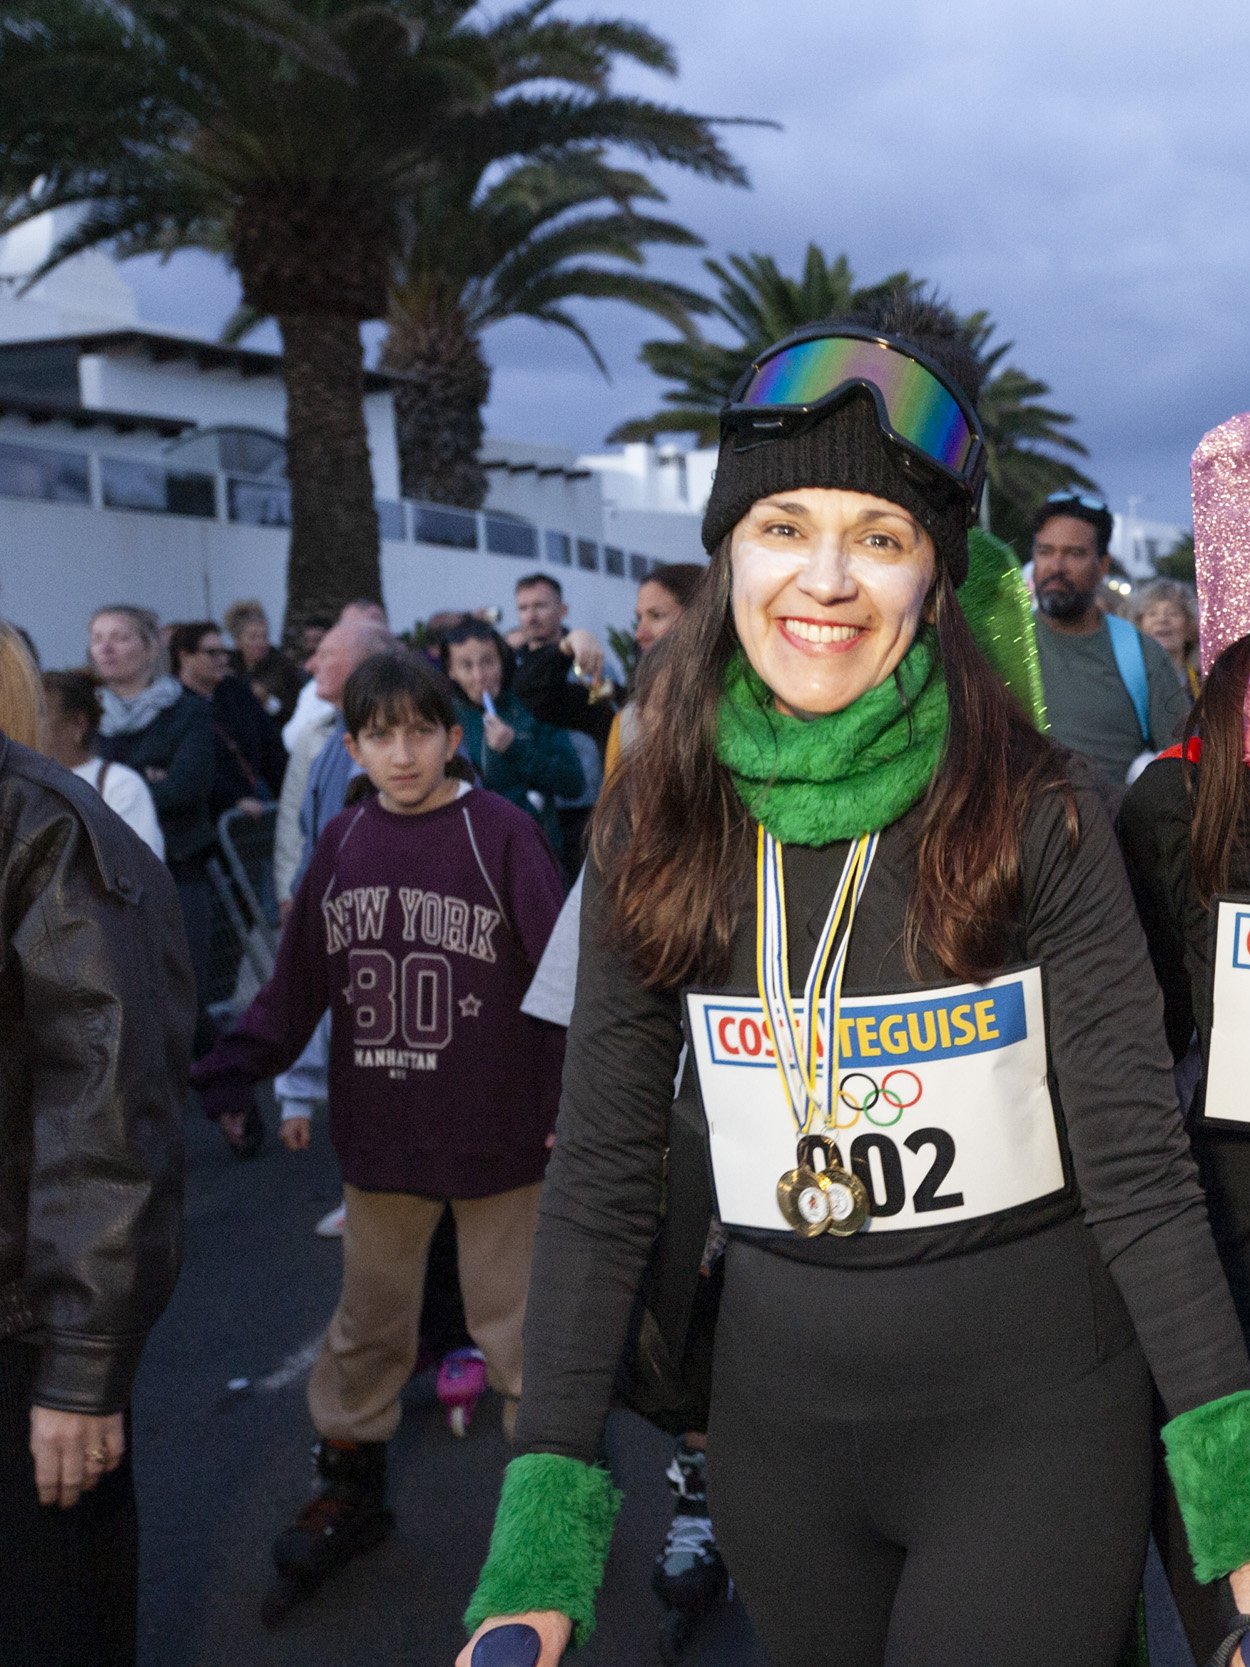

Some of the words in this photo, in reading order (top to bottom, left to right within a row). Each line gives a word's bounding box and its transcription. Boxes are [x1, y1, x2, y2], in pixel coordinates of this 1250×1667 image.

[399, 887, 500, 964] YORK
[349, 950, 452, 1050] 80
[839, 1000, 999, 1058] TEGUISE
[354, 1048, 438, 1071] MANHATTAN
